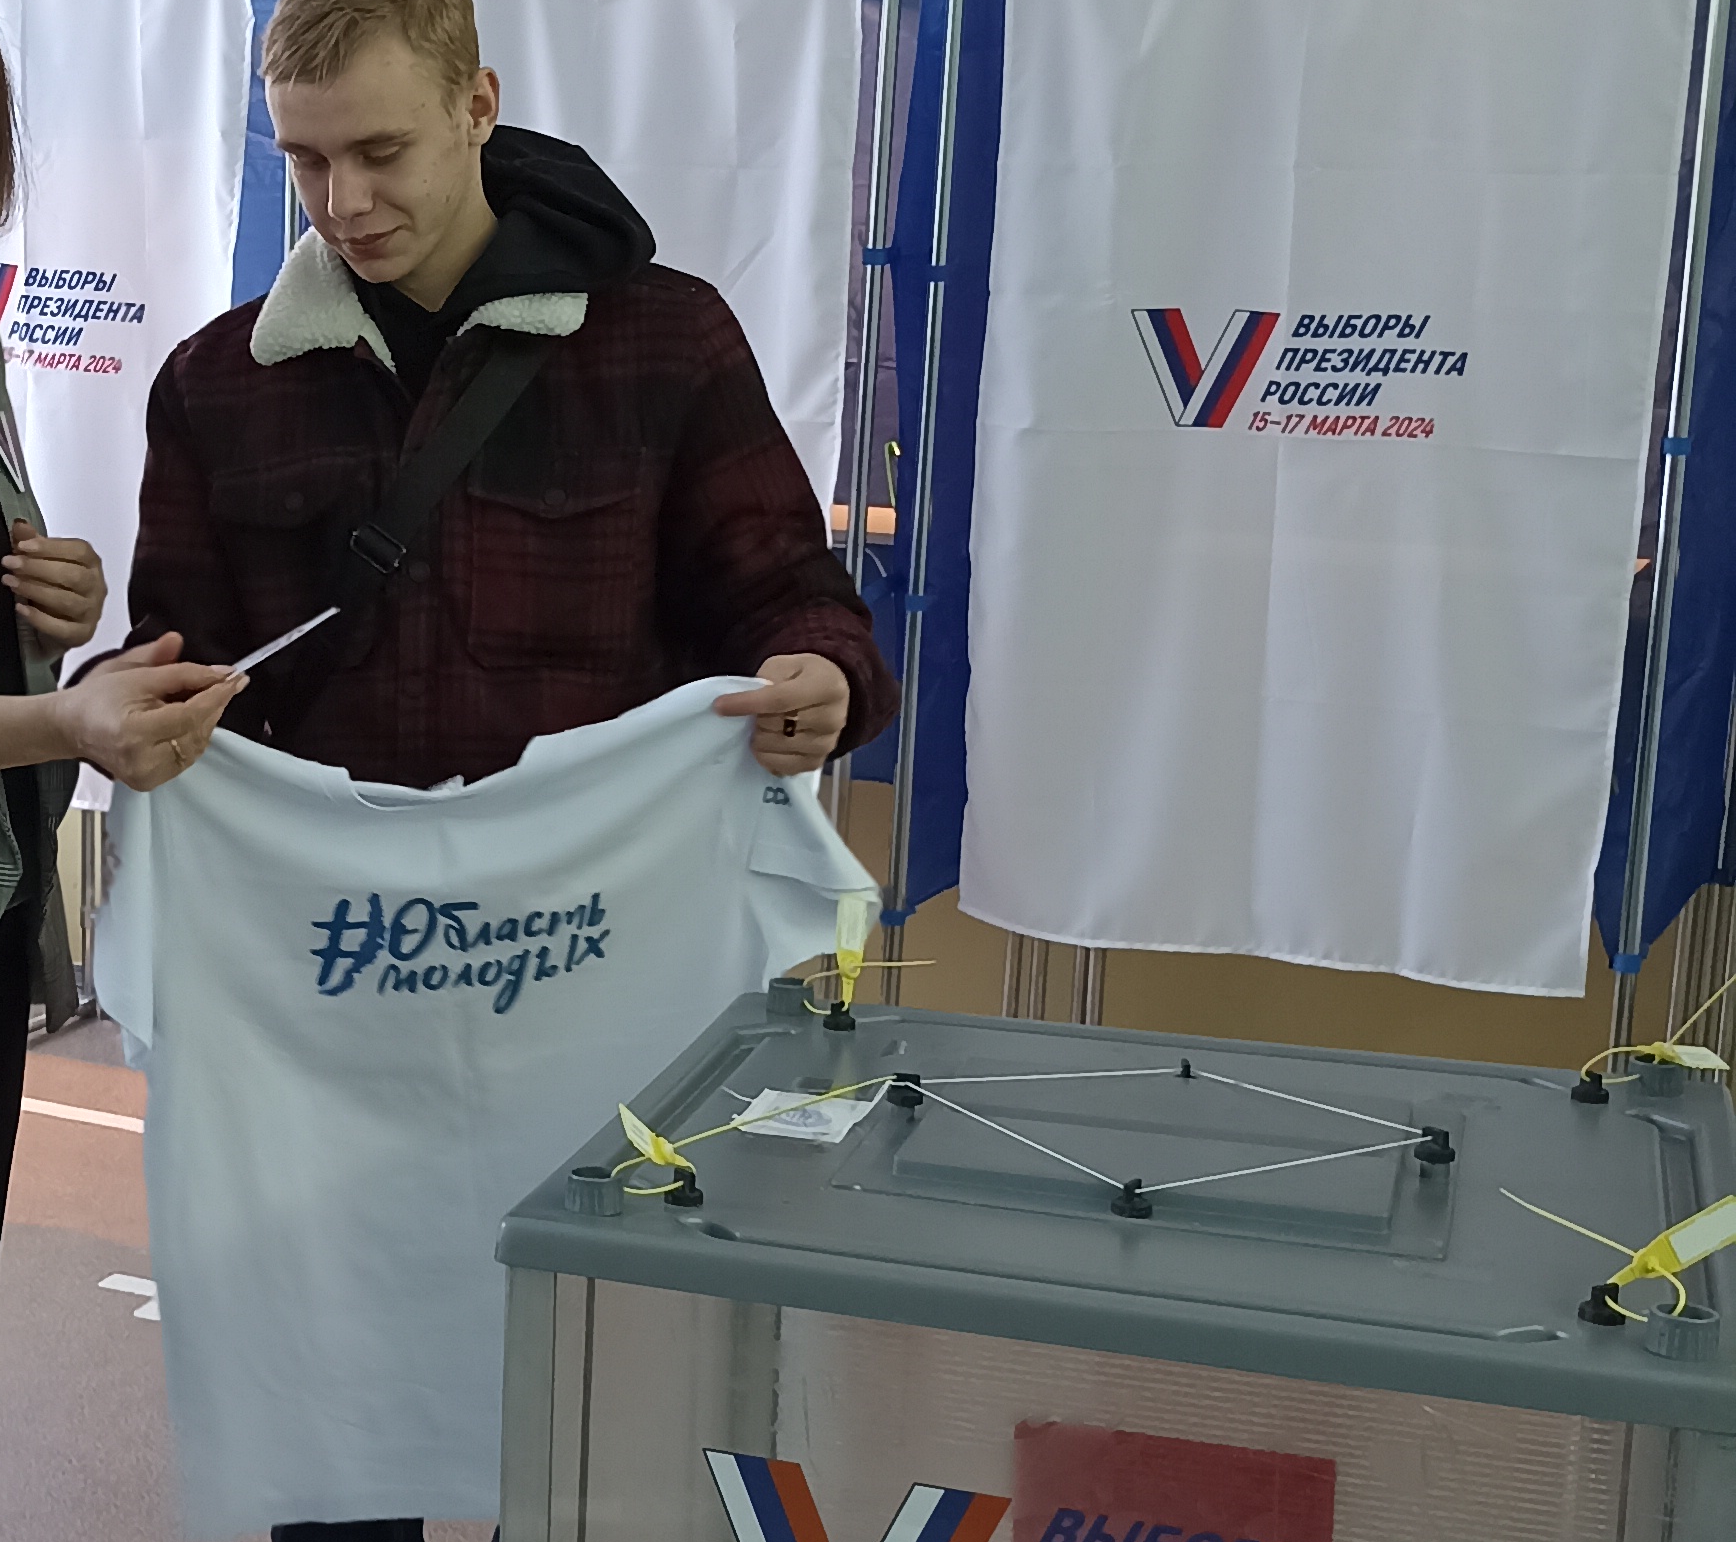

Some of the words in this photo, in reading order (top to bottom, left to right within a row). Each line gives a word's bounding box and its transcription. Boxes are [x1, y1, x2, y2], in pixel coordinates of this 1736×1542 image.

[24, 267, 117, 293] ВЫБОРЫ
[16, 294, 146, 324] ПРЕЗИДЕНТА
[8, 321, 83, 347] РОССИИ
[1291, 314, 1431, 340] ВЫБОРЫ
[34, 352, 81, 372] МАРТА
[83, 355, 123, 374] 2024
[1275, 348, 1469, 377] ПРЕЗИДЕНТА
[1260, 381, 1383, 407] РОССИИ
[1307, 415, 1381, 437] МАРТА
[1381, 416, 1435, 439] 2024
[377, 929, 611, 1015] молодых
